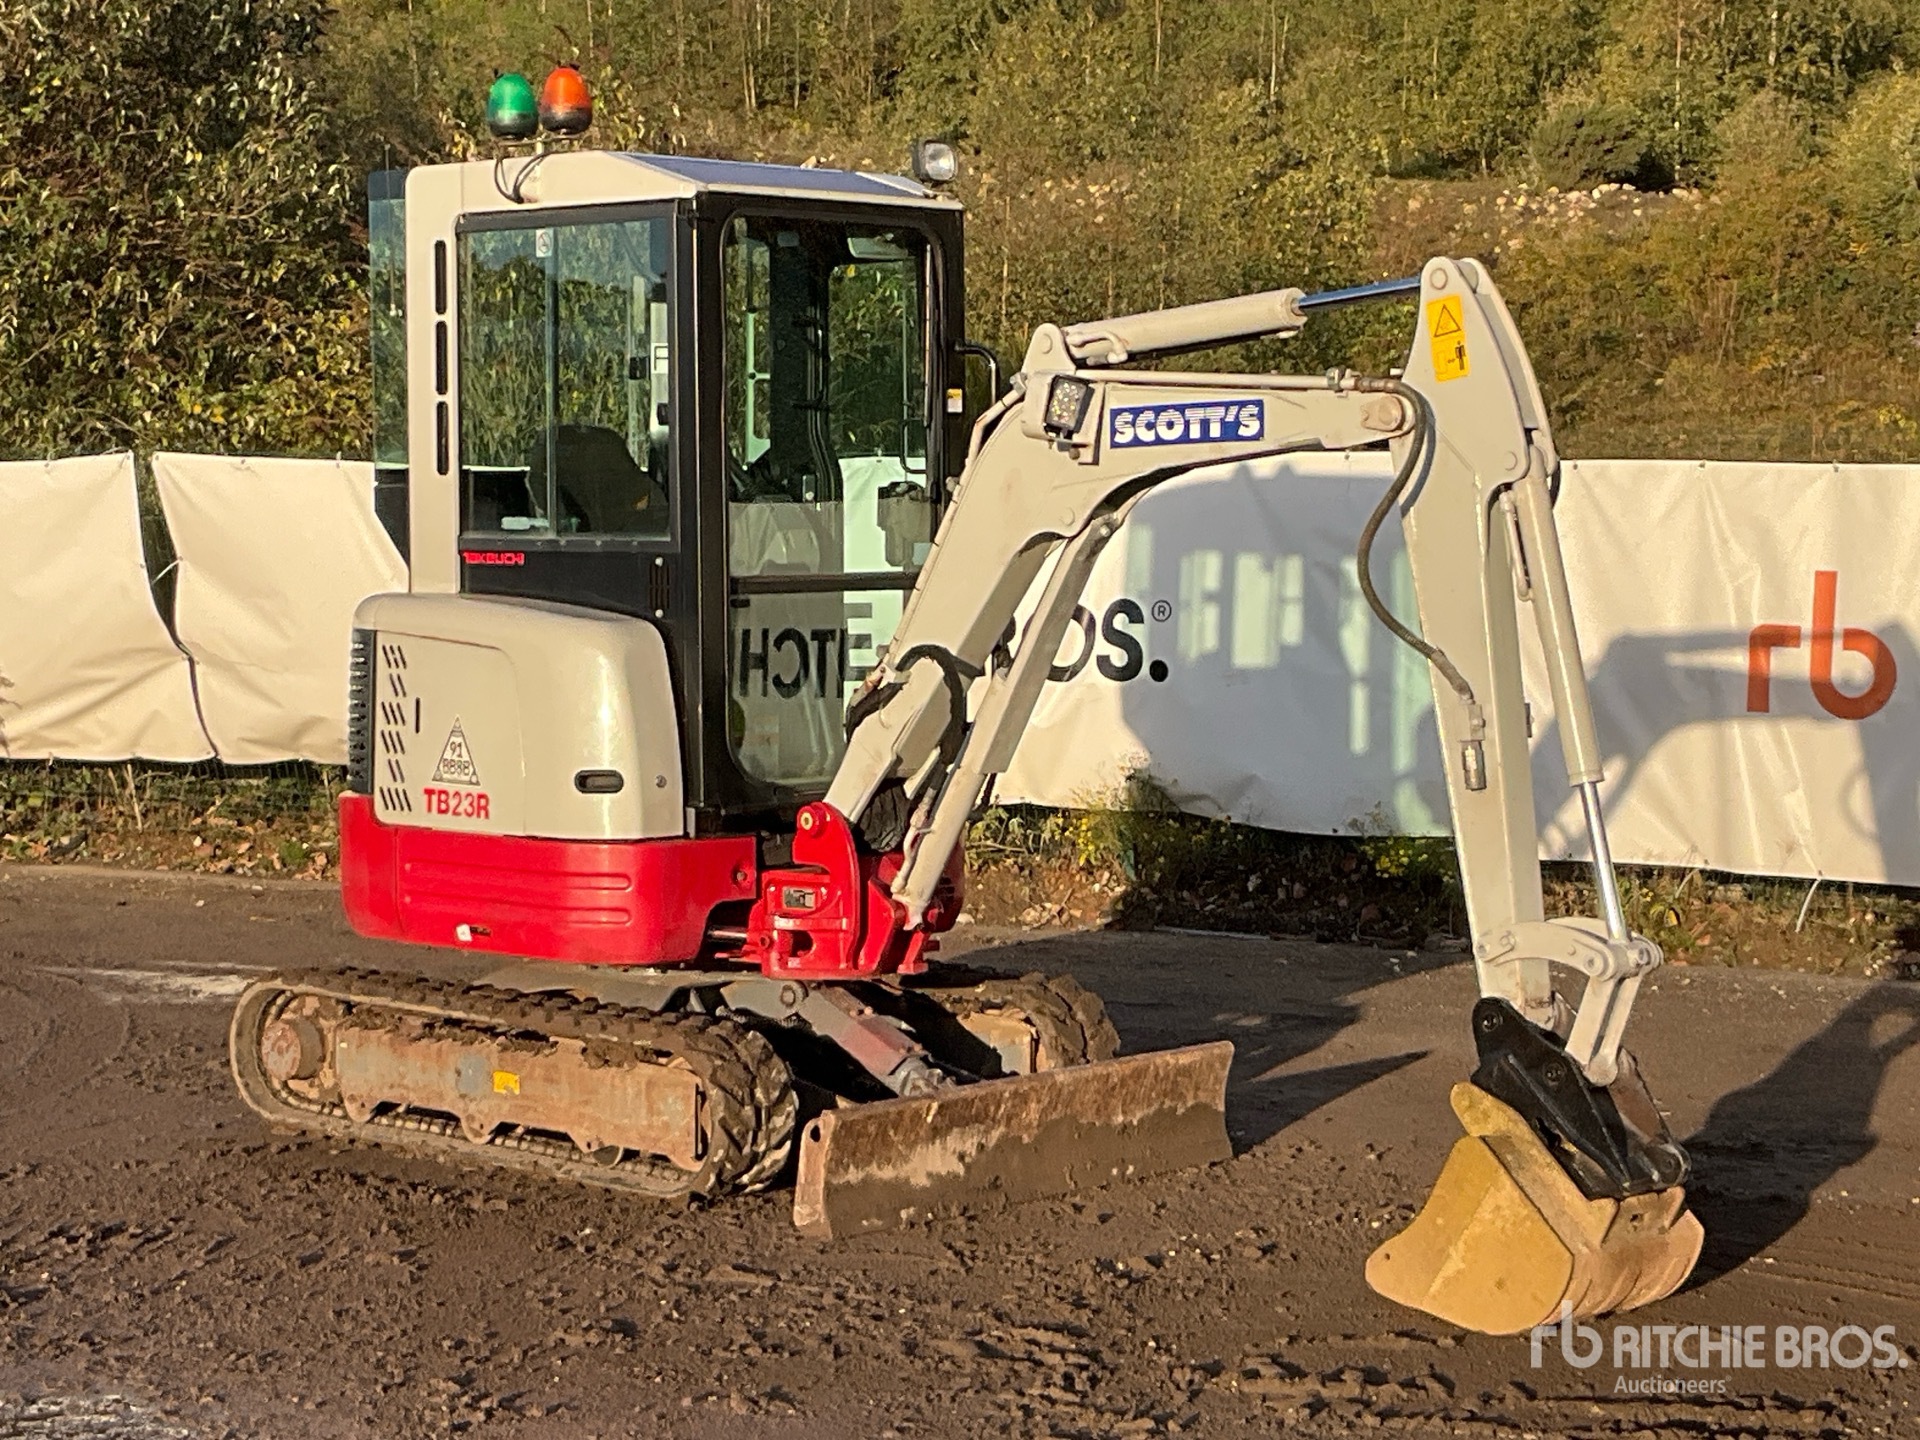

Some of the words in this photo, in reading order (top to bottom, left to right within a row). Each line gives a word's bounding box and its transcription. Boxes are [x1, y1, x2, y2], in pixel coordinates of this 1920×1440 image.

[1114, 404, 1260, 444] SCOTT'S
[1747, 570, 1897, 721] rb
[449, 740, 463, 759] 91
[423, 787, 490, 820] TB23R
